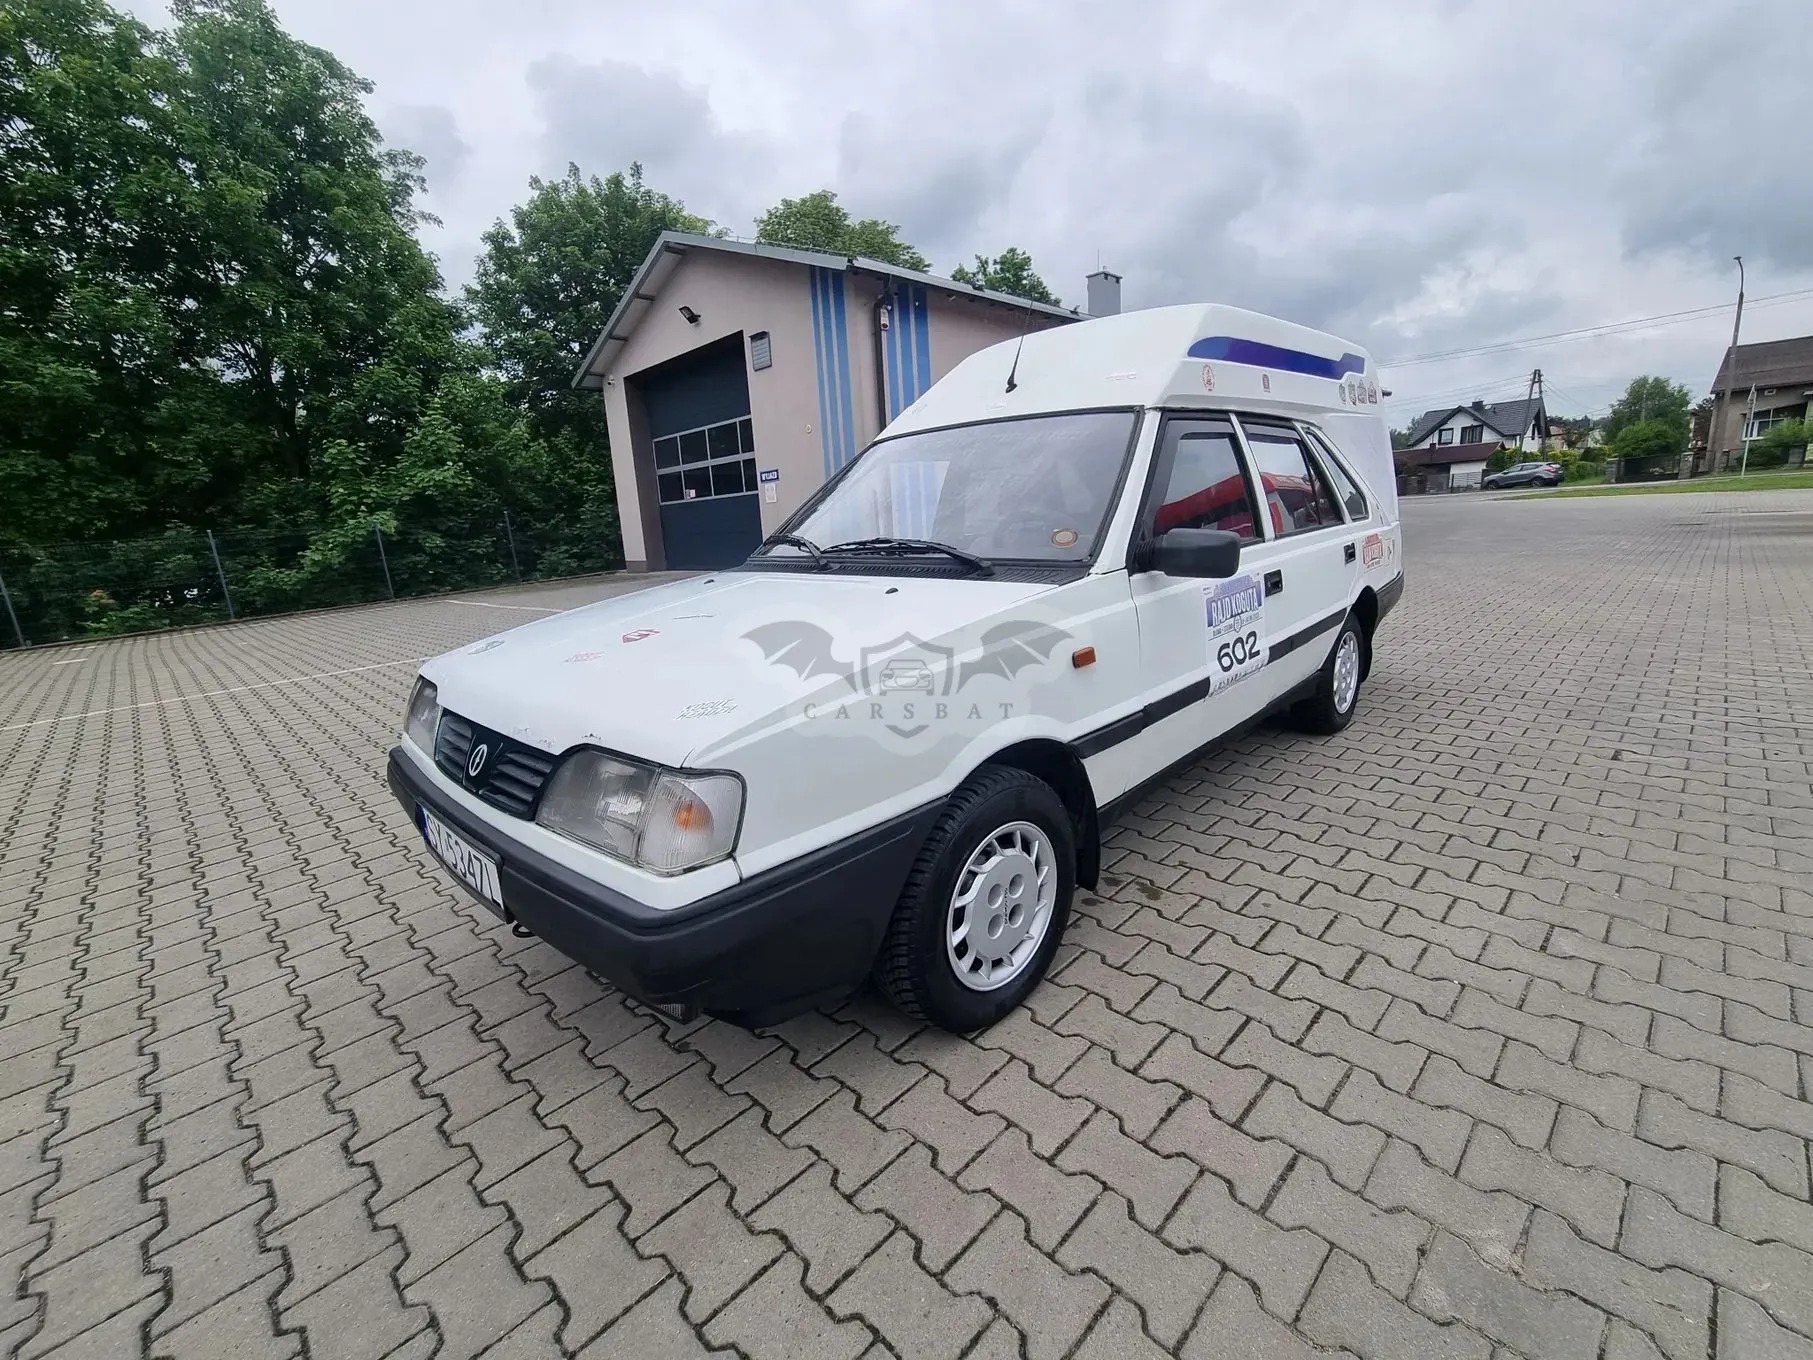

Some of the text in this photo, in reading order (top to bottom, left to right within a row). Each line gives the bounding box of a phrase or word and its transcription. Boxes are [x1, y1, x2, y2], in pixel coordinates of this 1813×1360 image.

[1212, 594, 1232, 628] RAJD
[1231, 586, 1260, 617] KOGUTA
[1217, 630, 1261, 673] 602
